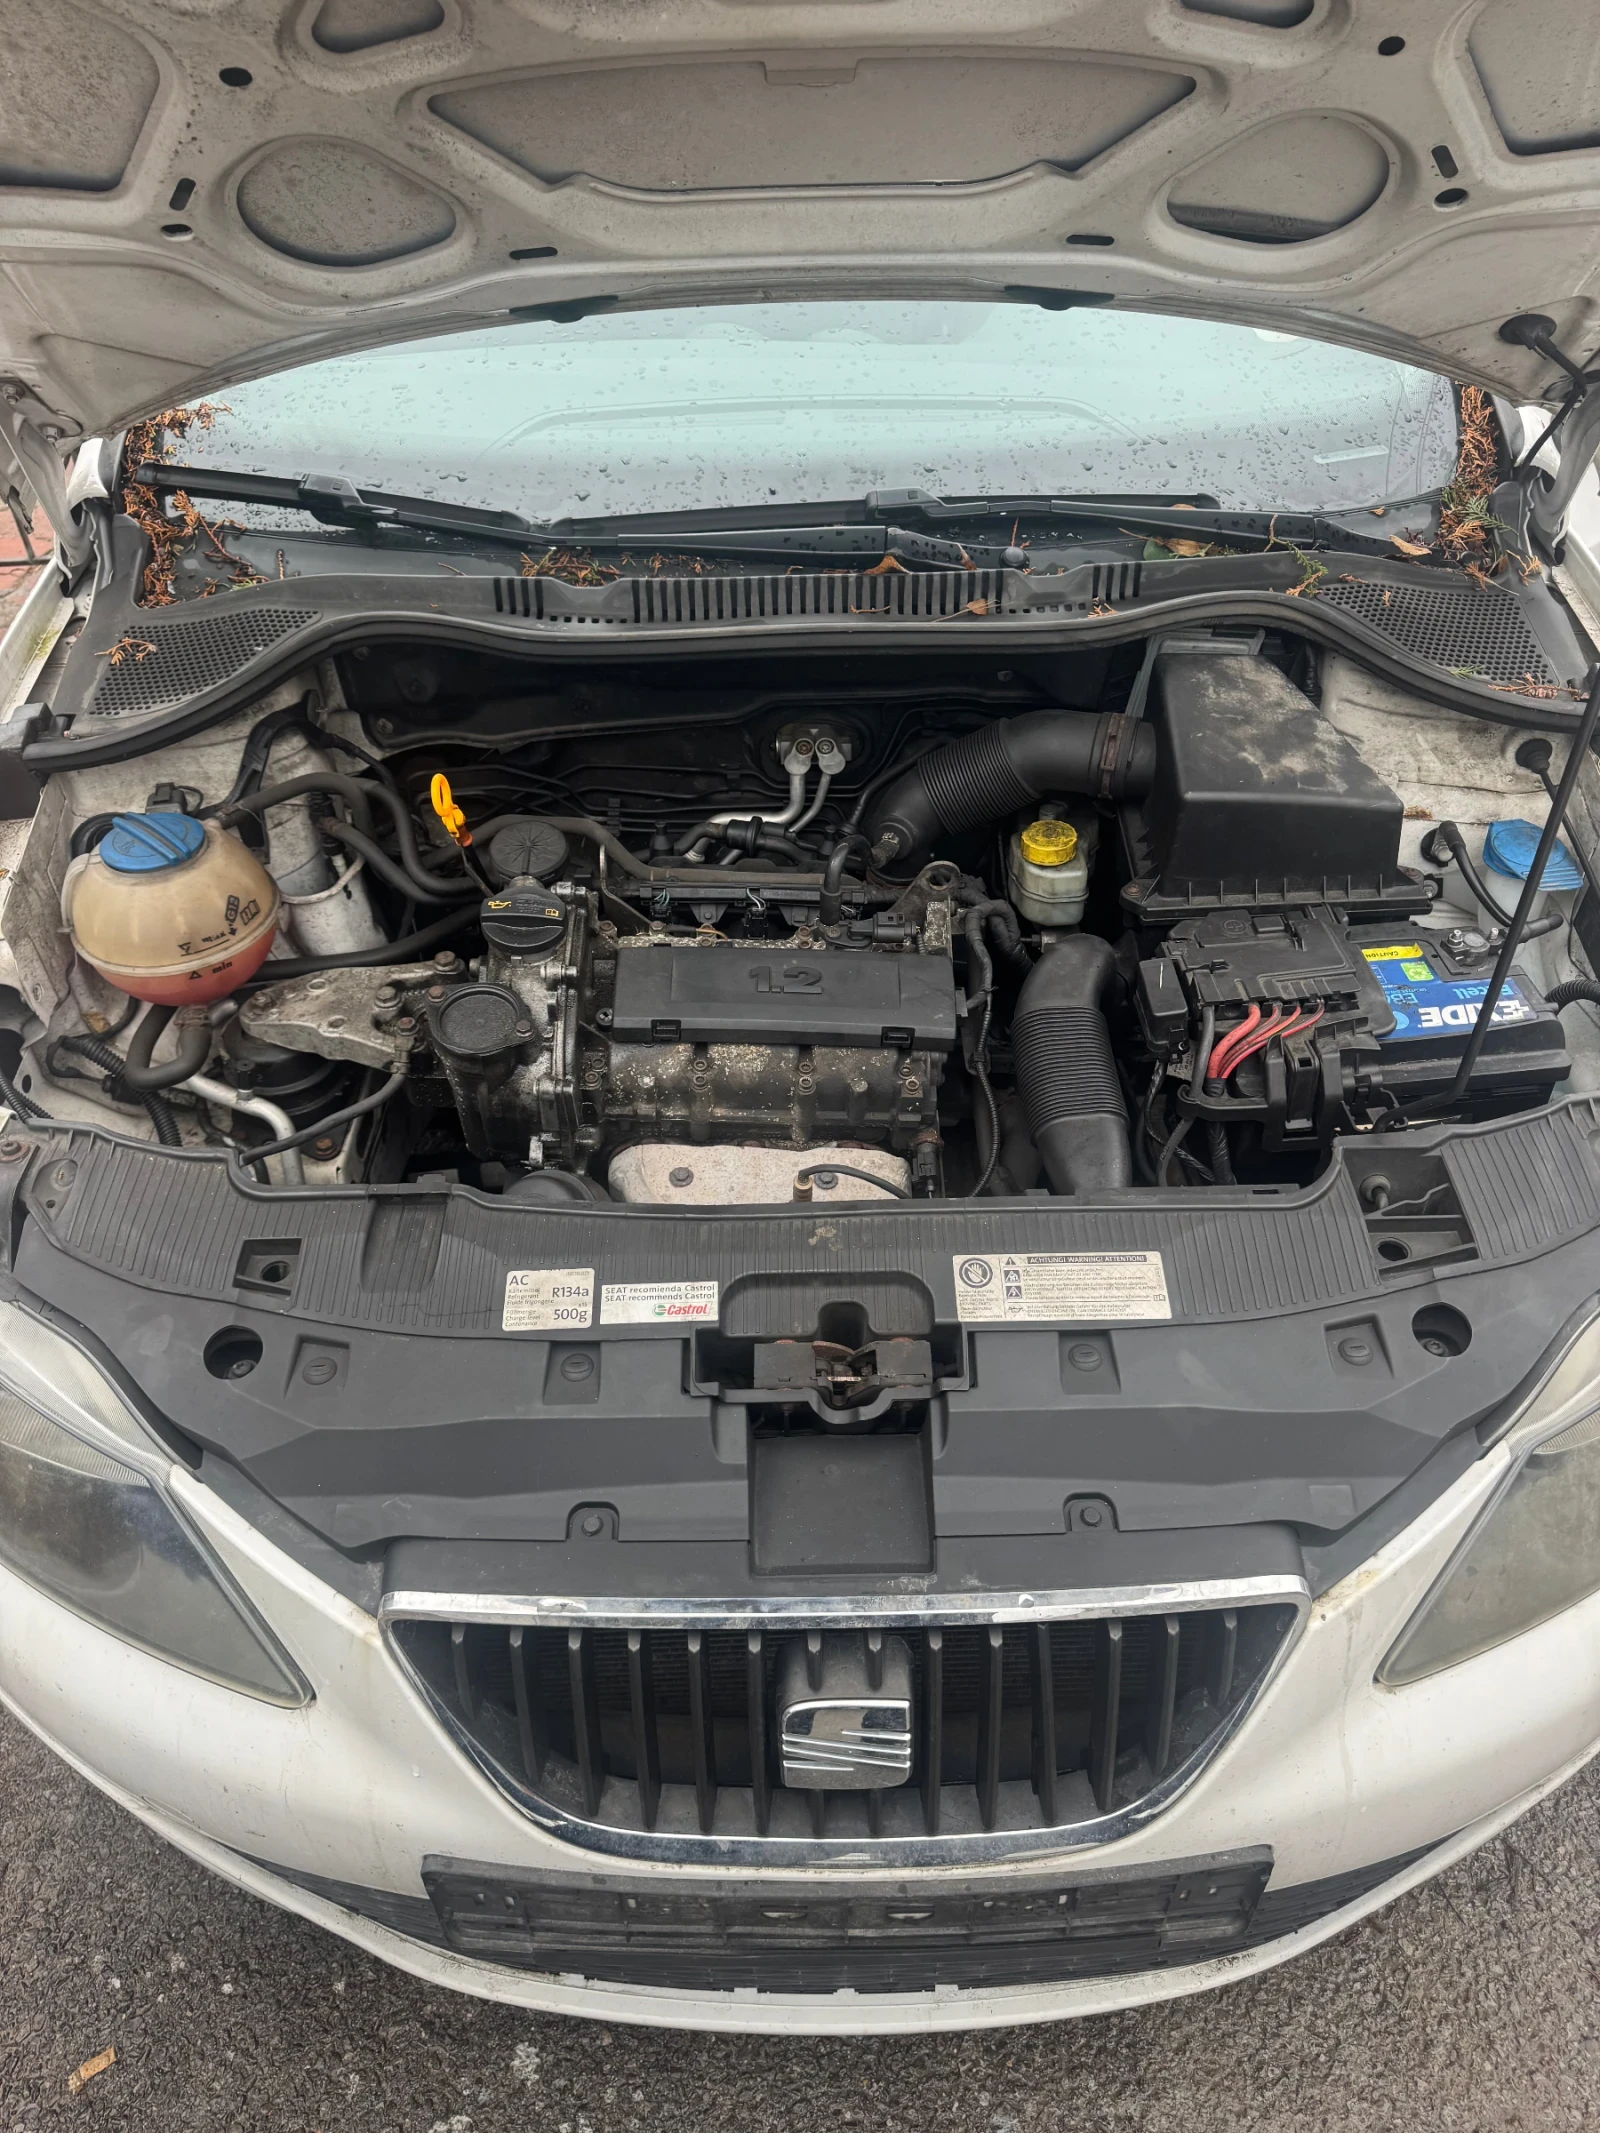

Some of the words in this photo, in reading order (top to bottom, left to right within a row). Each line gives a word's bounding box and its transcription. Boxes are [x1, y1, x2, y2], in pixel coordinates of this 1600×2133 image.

[1365, 951, 1399, 959] CAUTION
[212, 961, 233, 974] min
[750, 965, 823, 995] 1.2
[1452, 984, 1514, 999] Ecell
[1030, 1256, 1066, 1264] ACHTUNG!
[508, 1275, 530, 1286] AC
[552, 1286, 589, 1298] R134a
[605, 1286, 628, 1294] SEAT
[629, 1285, 682, 1293] recomienda
[684, 1283, 715, 1292] Castrol
[604, 1294, 627, 1302] SEAT
[628, 1293, 683, 1301] recommends
[684, 1291, 715, 1300] Castrol
[667, 1303, 708, 1315] Castrol
[553, 1308, 588, 1323] 500g
